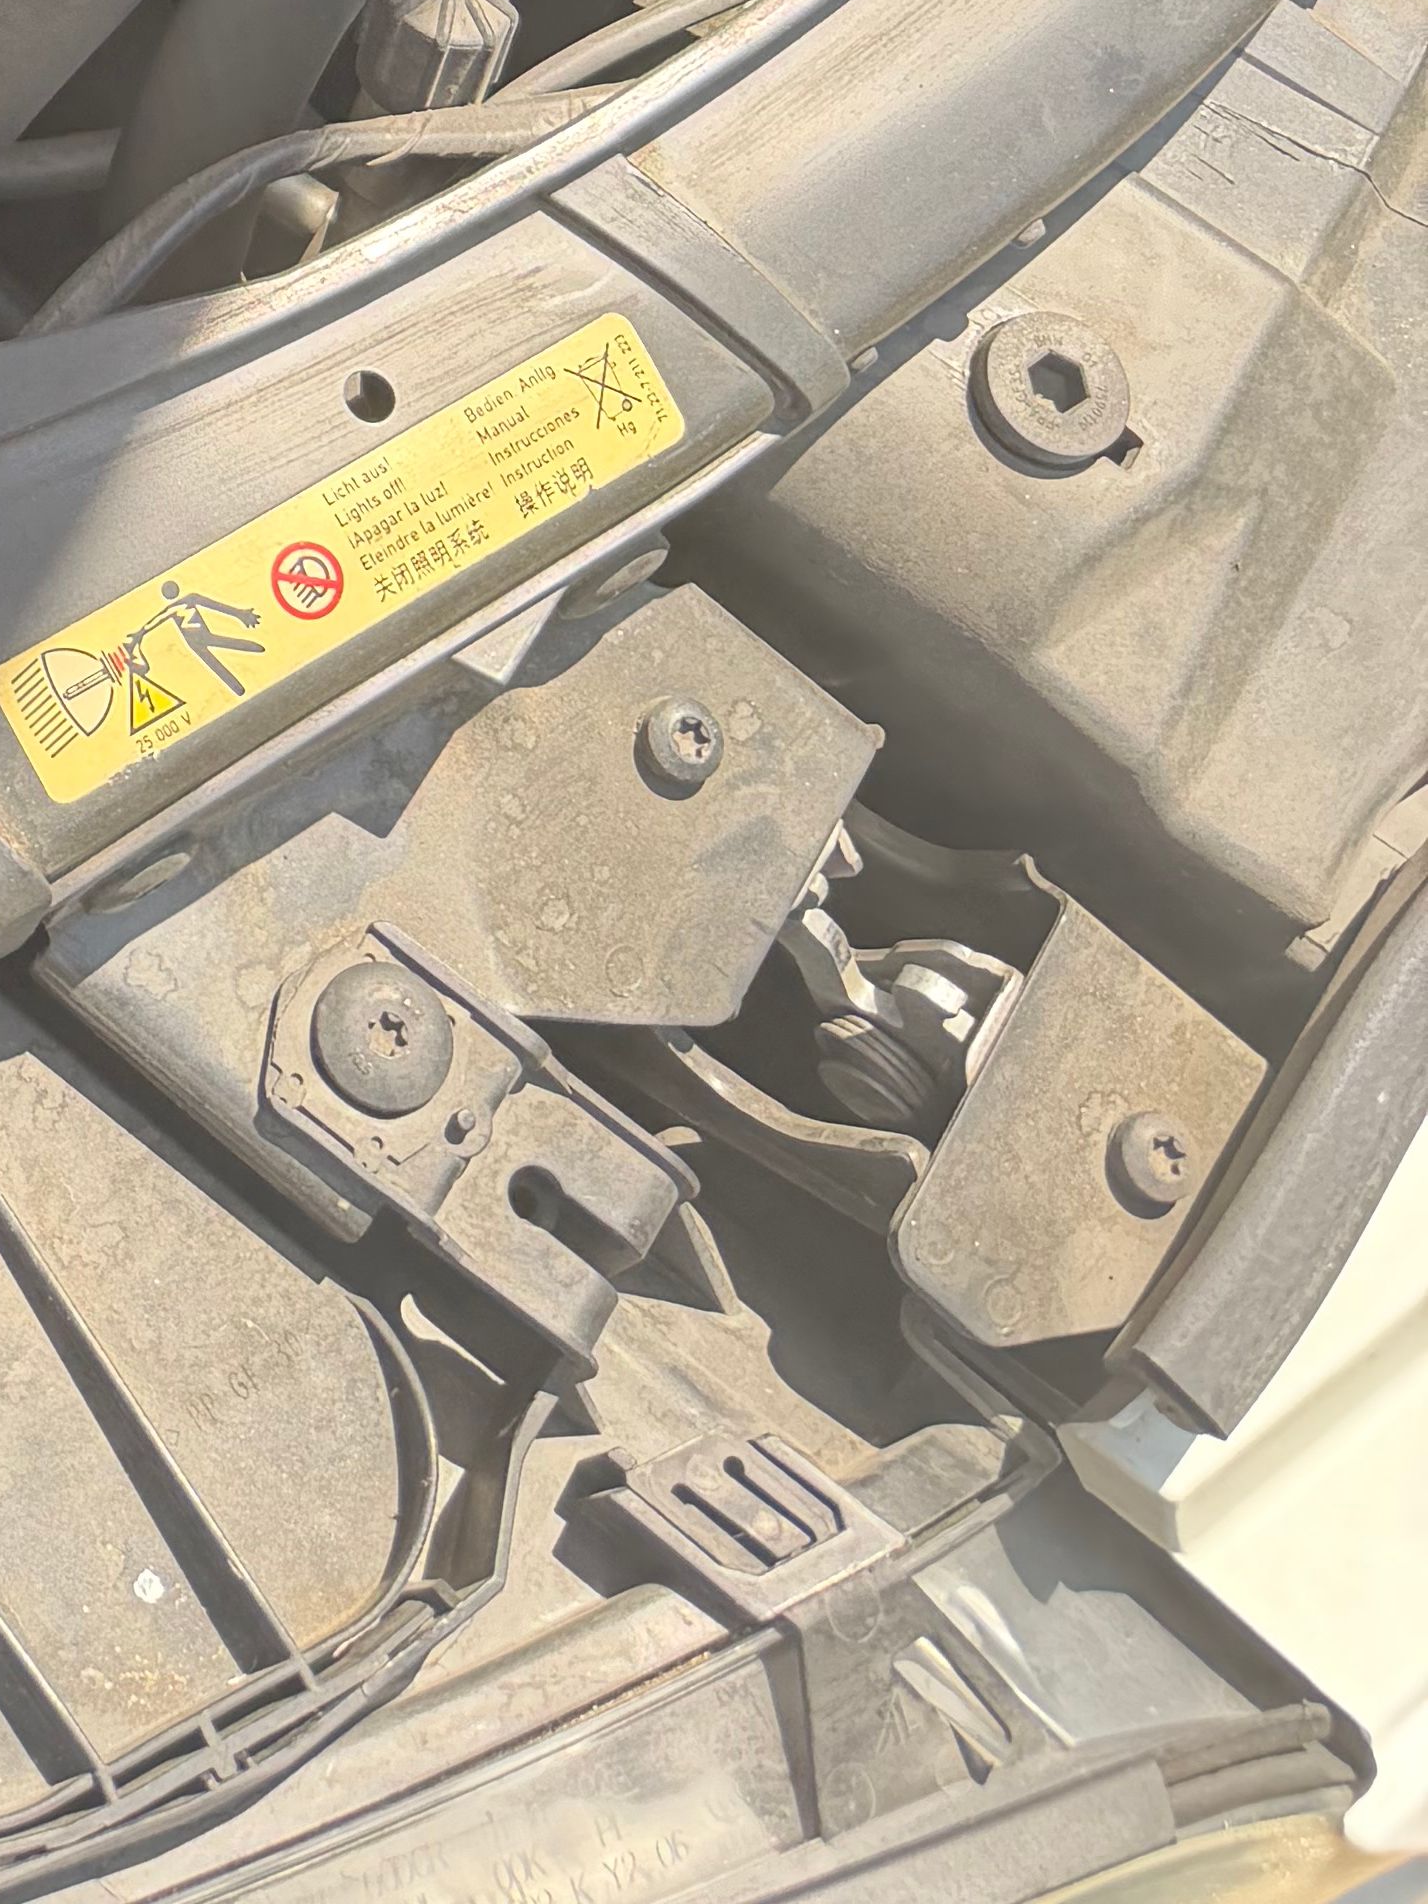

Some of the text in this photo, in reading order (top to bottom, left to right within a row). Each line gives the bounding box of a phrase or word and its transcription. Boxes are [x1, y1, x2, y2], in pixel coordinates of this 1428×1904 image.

[476, 407, 531, 445] Manual
[488, 406, 581, 466] Instrucciones
[616, 421, 638, 437] Hg
[322, 455, 393, 507] Licht aus!
[500, 437, 575, 489] Instruction
[334, 488, 382, 528] Lights
[407, 492, 421, 515] la
[422, 480, 449, 509] luz!
[513, 457, 595, 519] 操作说明
[419, 517, 436, 536] la
[373, 519, 491, 603] 关闭照明系统
[135, 711, 192, 754] 25 000 V
